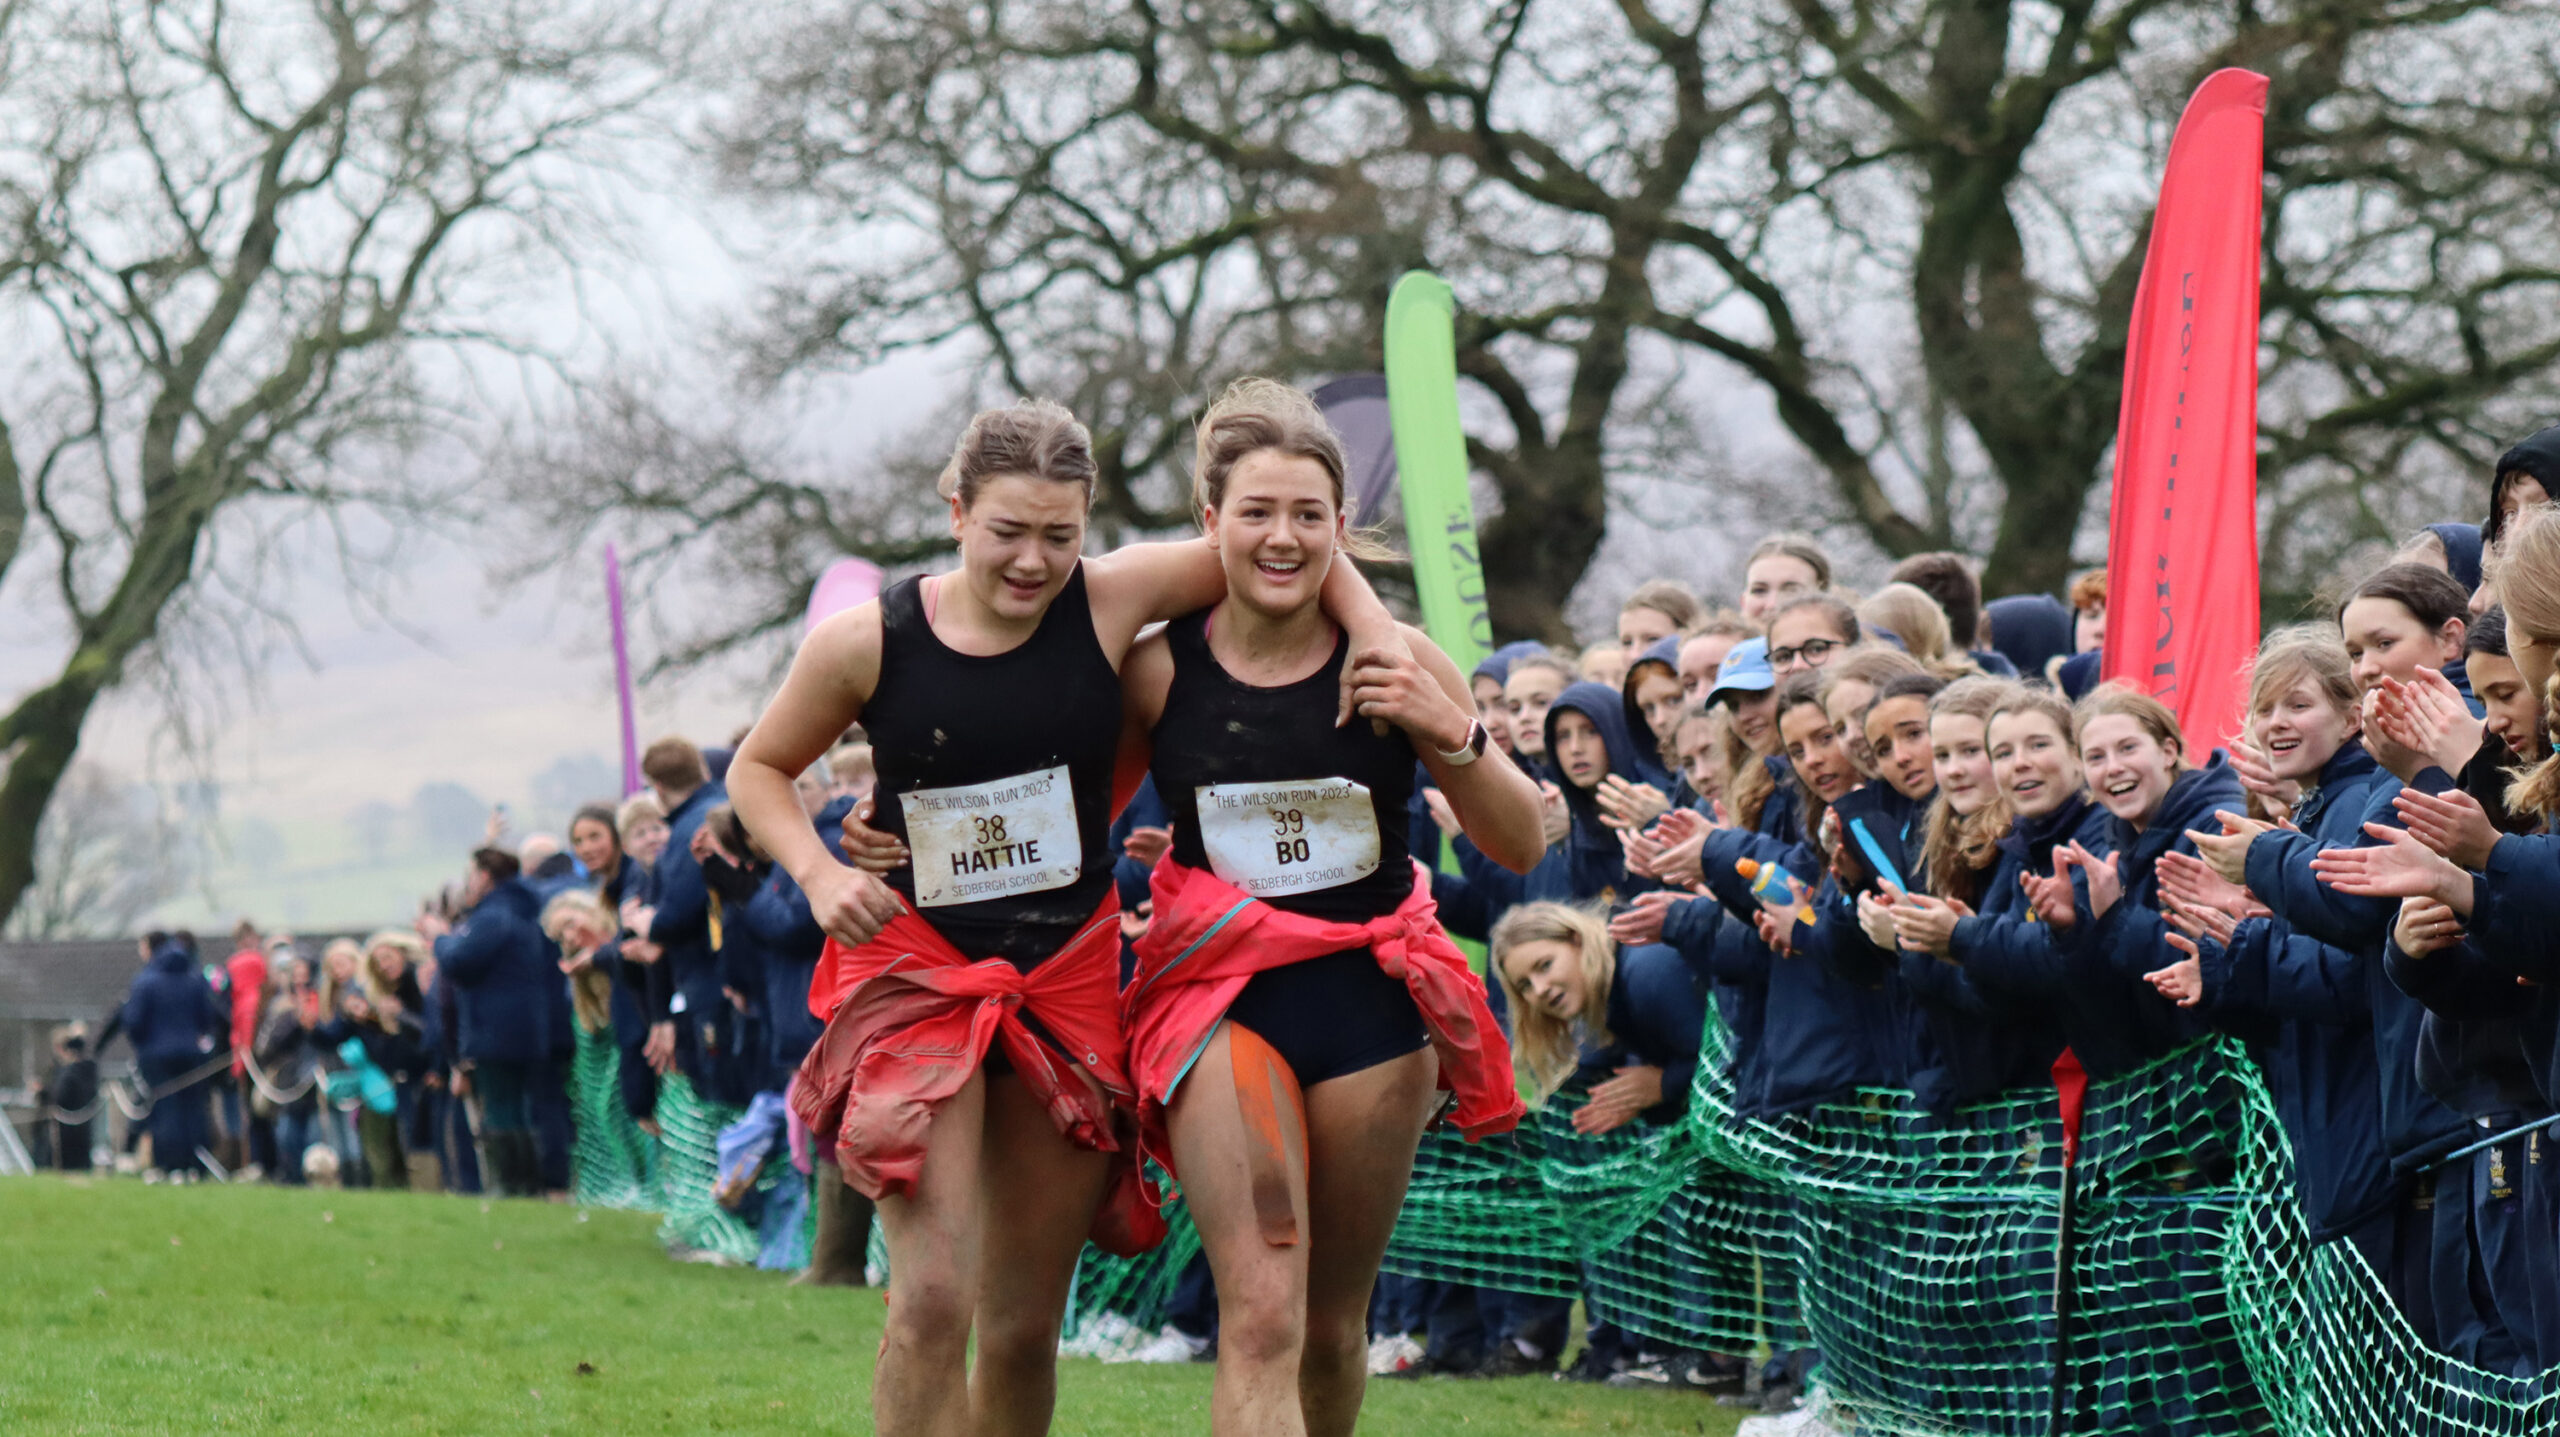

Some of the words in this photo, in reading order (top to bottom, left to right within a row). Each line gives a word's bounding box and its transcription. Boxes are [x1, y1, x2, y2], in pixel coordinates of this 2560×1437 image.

[920, 797, 943, 811] THE
[944, 793, 989, 809] WILSON
[993, 788, 1019, 803] RUN
[1023, 779, 1052, 798] 2023
[1216, 796, 1238, 809] THE
[1240, 791, 1288, 806] WILSON
[1291, 790, 1317, 802] RUN
[1320, 786, 1350, 801] 2023
[974, 814, 1006, 844] 38
[1272, 808, 1304, 836] 39
[951, 840, 1042, 876] HATTIE
[1275, 838, 1310, 865] BO
[952, 881, 1007, 897] SEDBERGH
[1009, 873, 1050, 888] SCHOOL
[1248, 876, 1303, 890] SEDBERGH
[1305, 868, 1346, 884] SCHOOL
